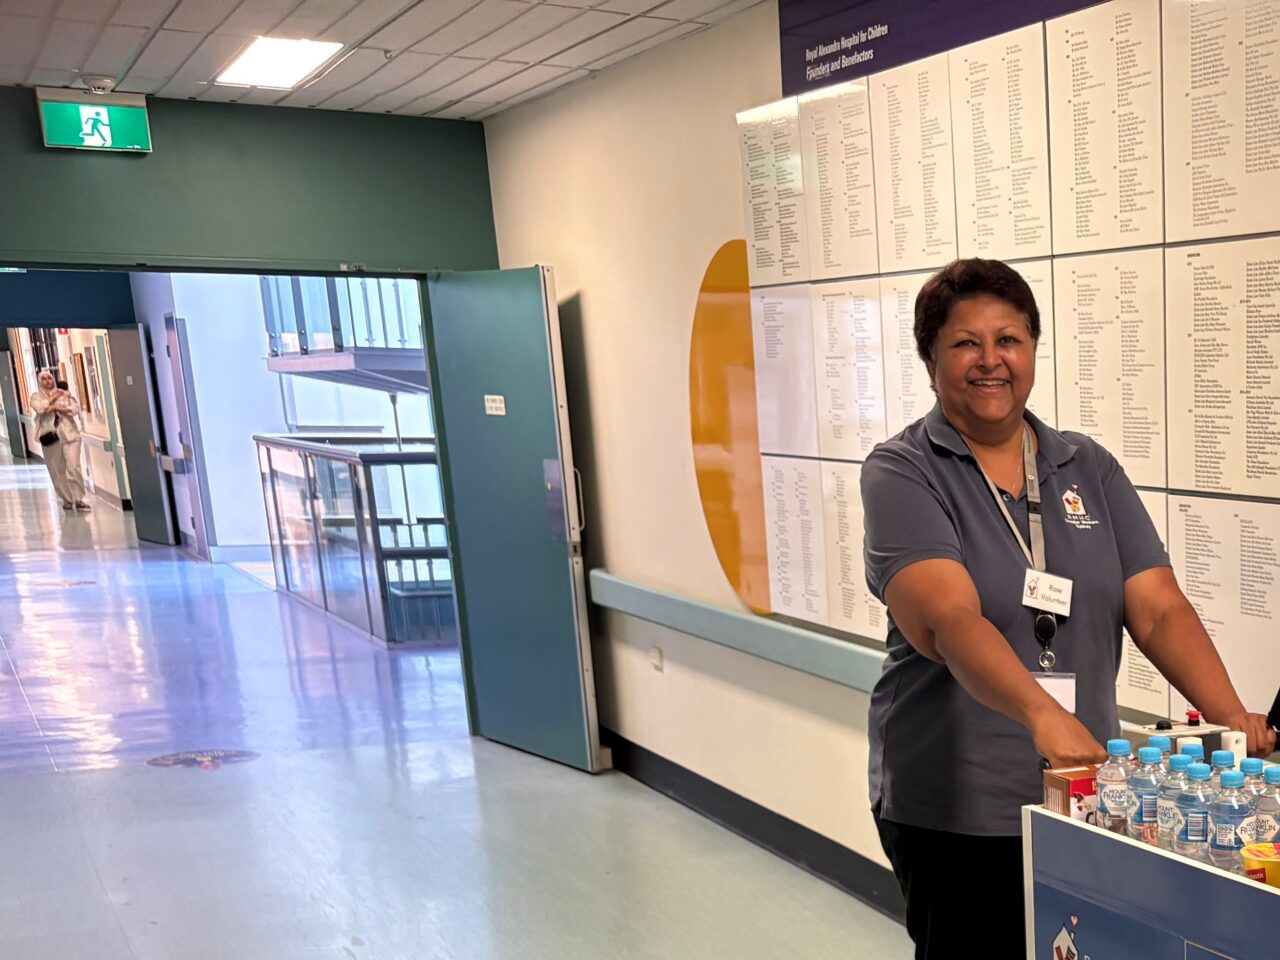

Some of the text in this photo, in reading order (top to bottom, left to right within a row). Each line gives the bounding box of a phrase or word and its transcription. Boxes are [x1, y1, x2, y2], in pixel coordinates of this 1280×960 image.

[805, 45, 818, 62] Royal
[818, 40, 840, 57] Alexandra
[840, 32, 860, 50] Hospital
[867, 23, 888, 40] Children
[806, 49, 874, 81] Founders and Benefactors
